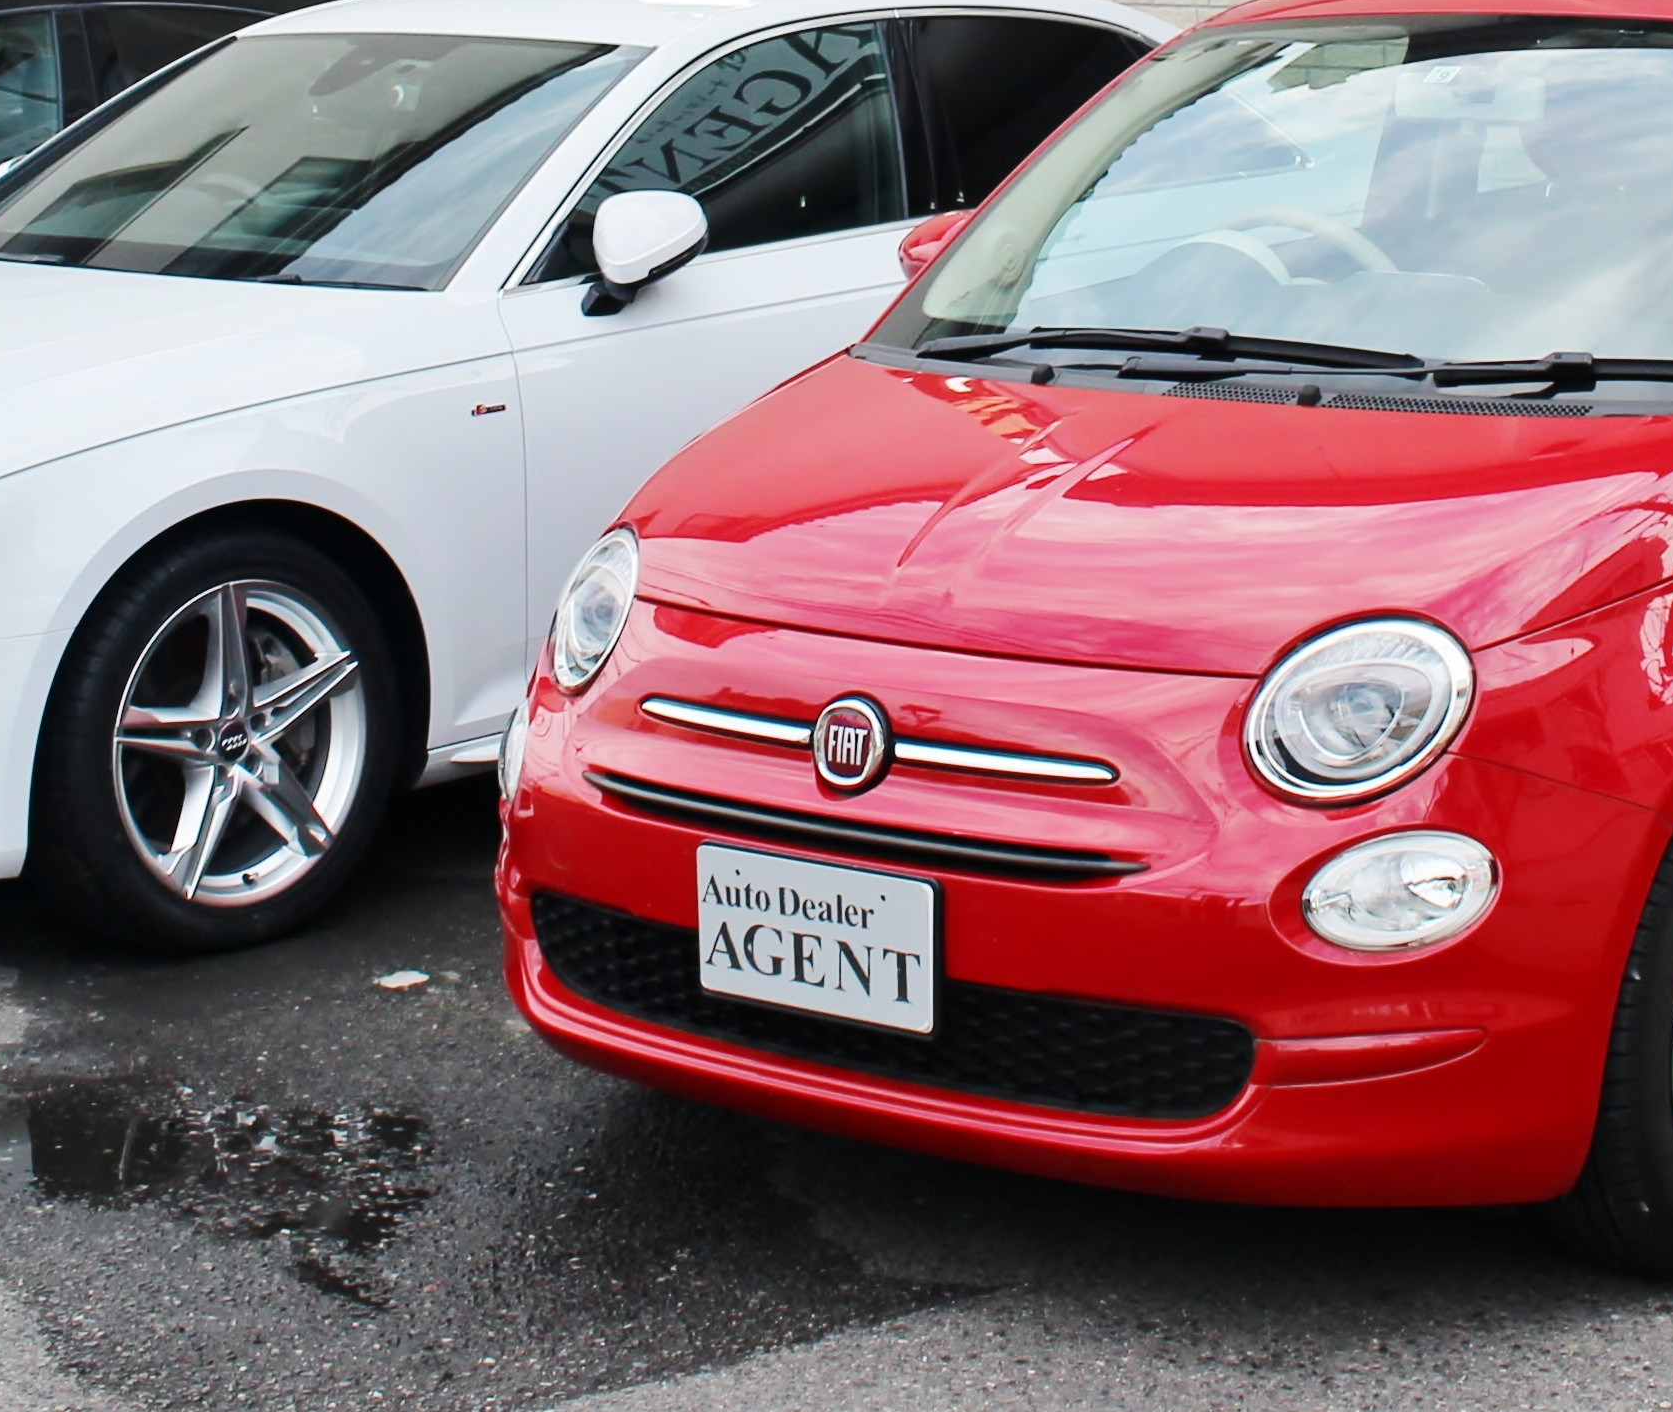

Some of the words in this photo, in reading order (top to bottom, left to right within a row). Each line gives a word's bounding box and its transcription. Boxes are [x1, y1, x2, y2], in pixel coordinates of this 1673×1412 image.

[827, 724, 869, 766] FIAT
[702, 873, 772, 913] Auto
[777, 886, 875, 930] Dealer
[705, 921, 922, 1005] AGENT
